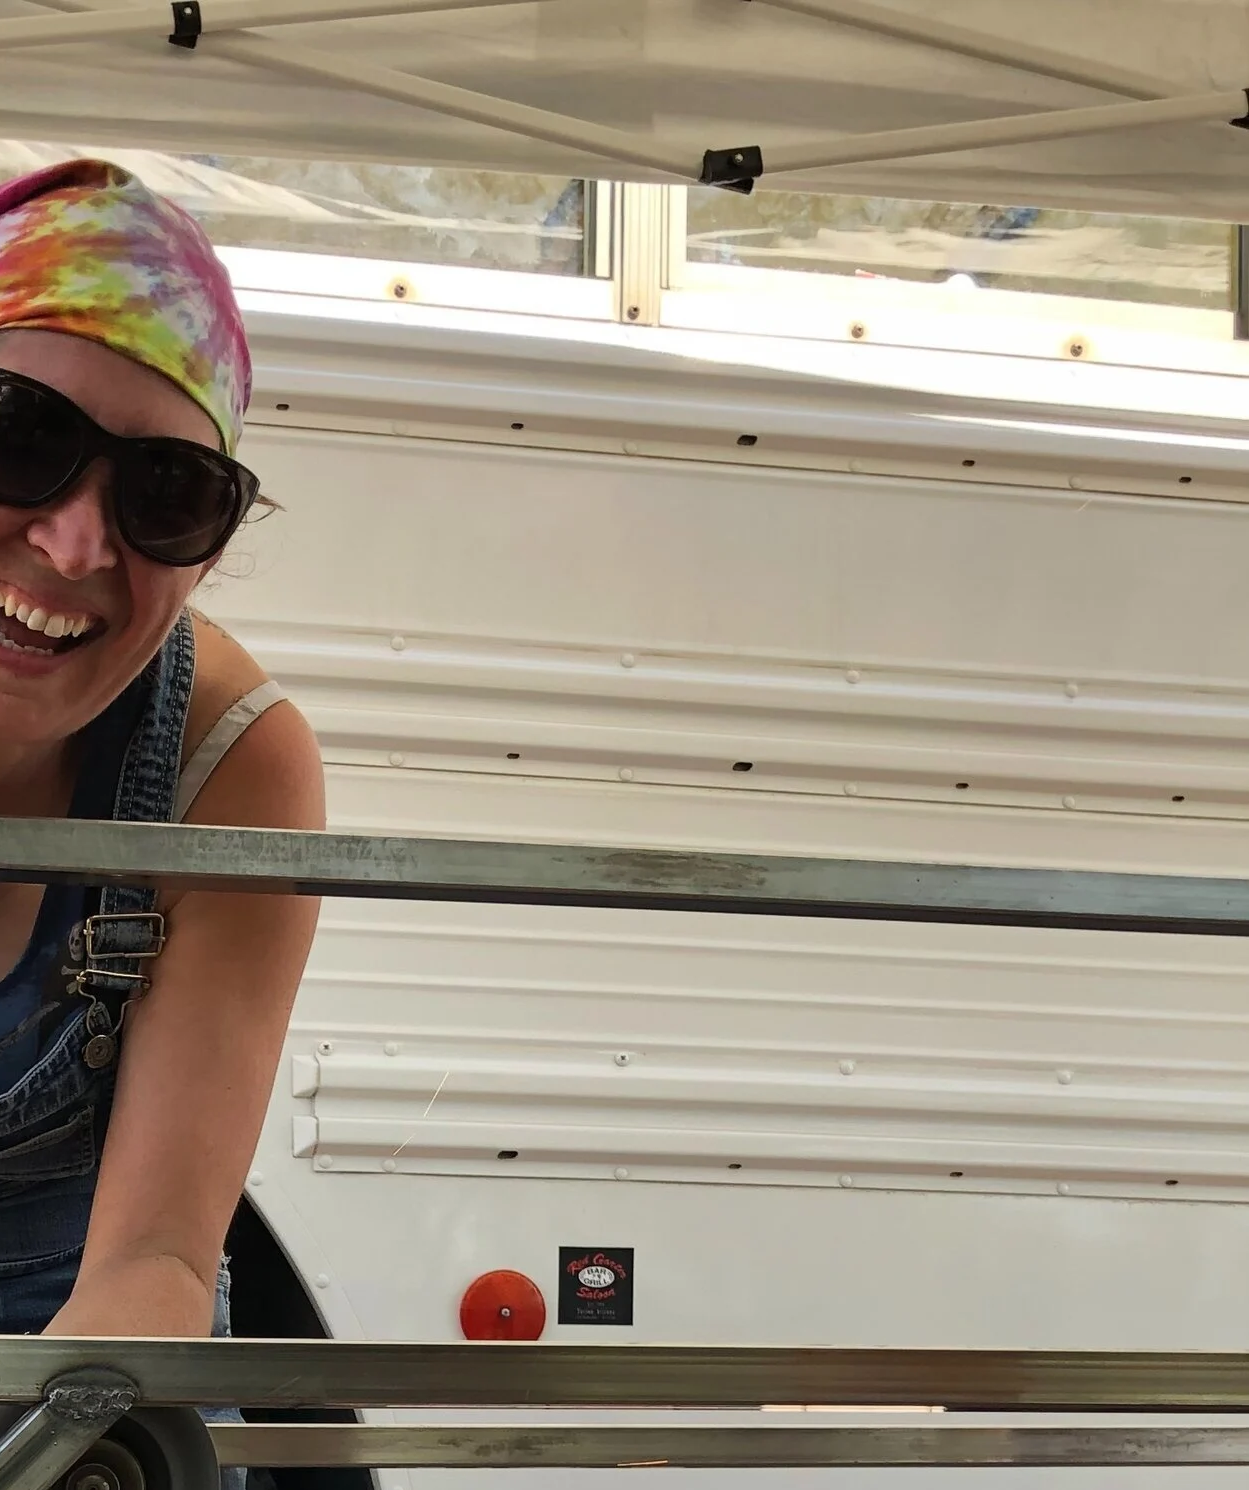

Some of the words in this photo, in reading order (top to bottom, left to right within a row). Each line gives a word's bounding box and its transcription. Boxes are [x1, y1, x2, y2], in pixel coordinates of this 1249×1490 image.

[566, 1254, 590, 1276] Red
[587, 1267, 606, 1275] BAR
[583, 1278, 609, 1286] GRILL
[576, 1286, 616, 1301] Saloon
